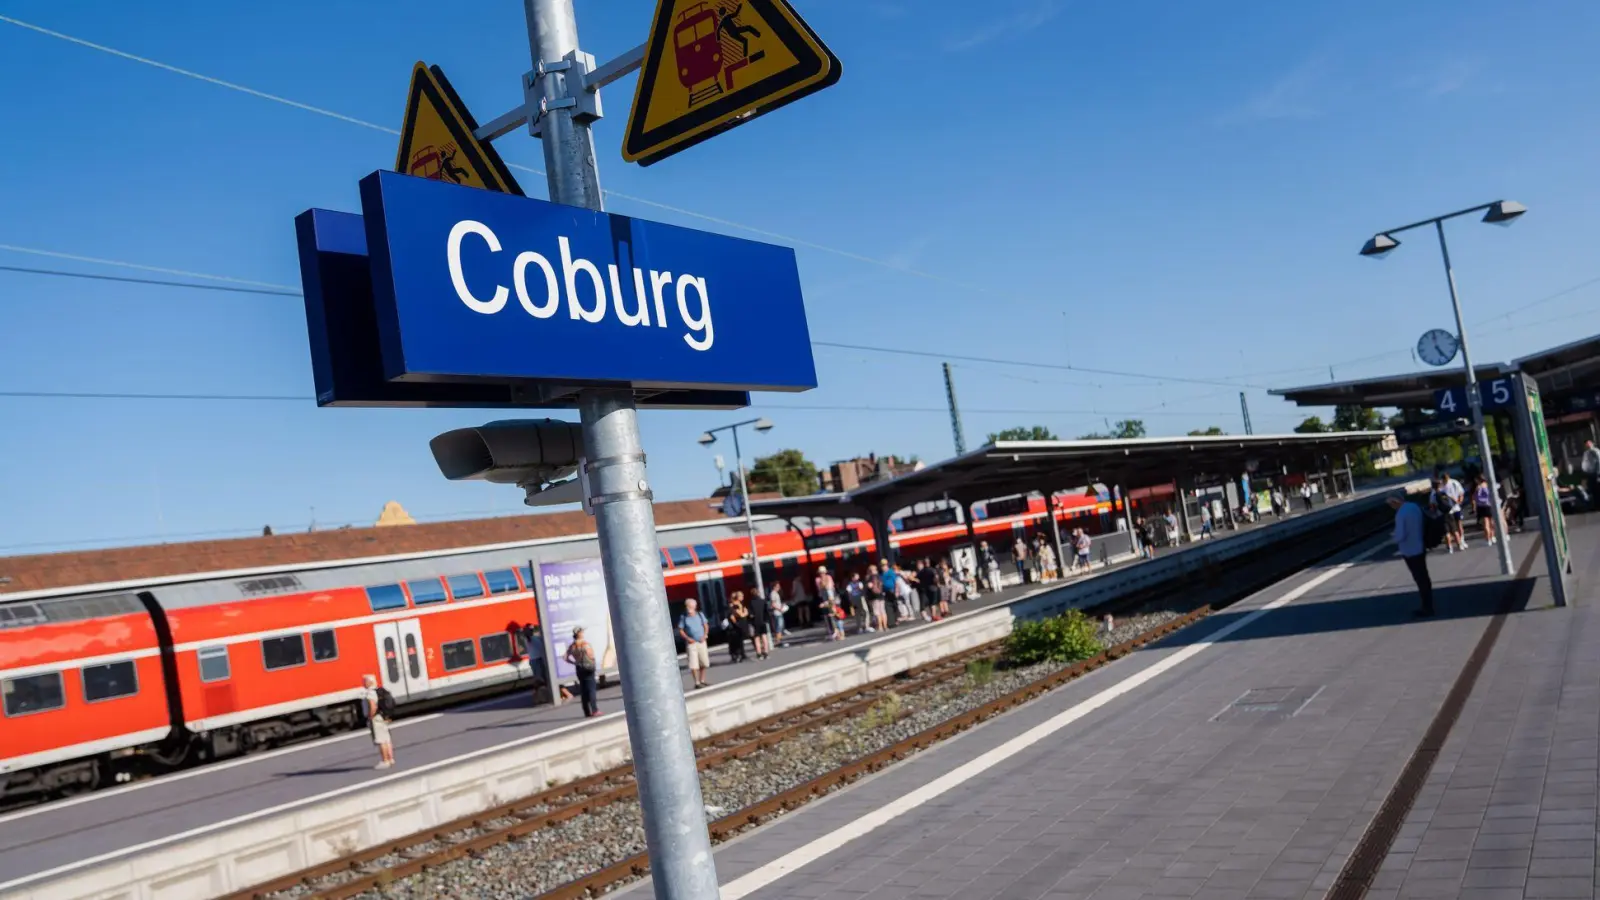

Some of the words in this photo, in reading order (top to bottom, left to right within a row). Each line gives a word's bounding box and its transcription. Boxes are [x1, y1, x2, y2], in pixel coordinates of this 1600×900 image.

[447, 220, 714, 351] Coburg
[1440, 390, 1456, 412] 4
[1492, 380, 1509, 403] 5
